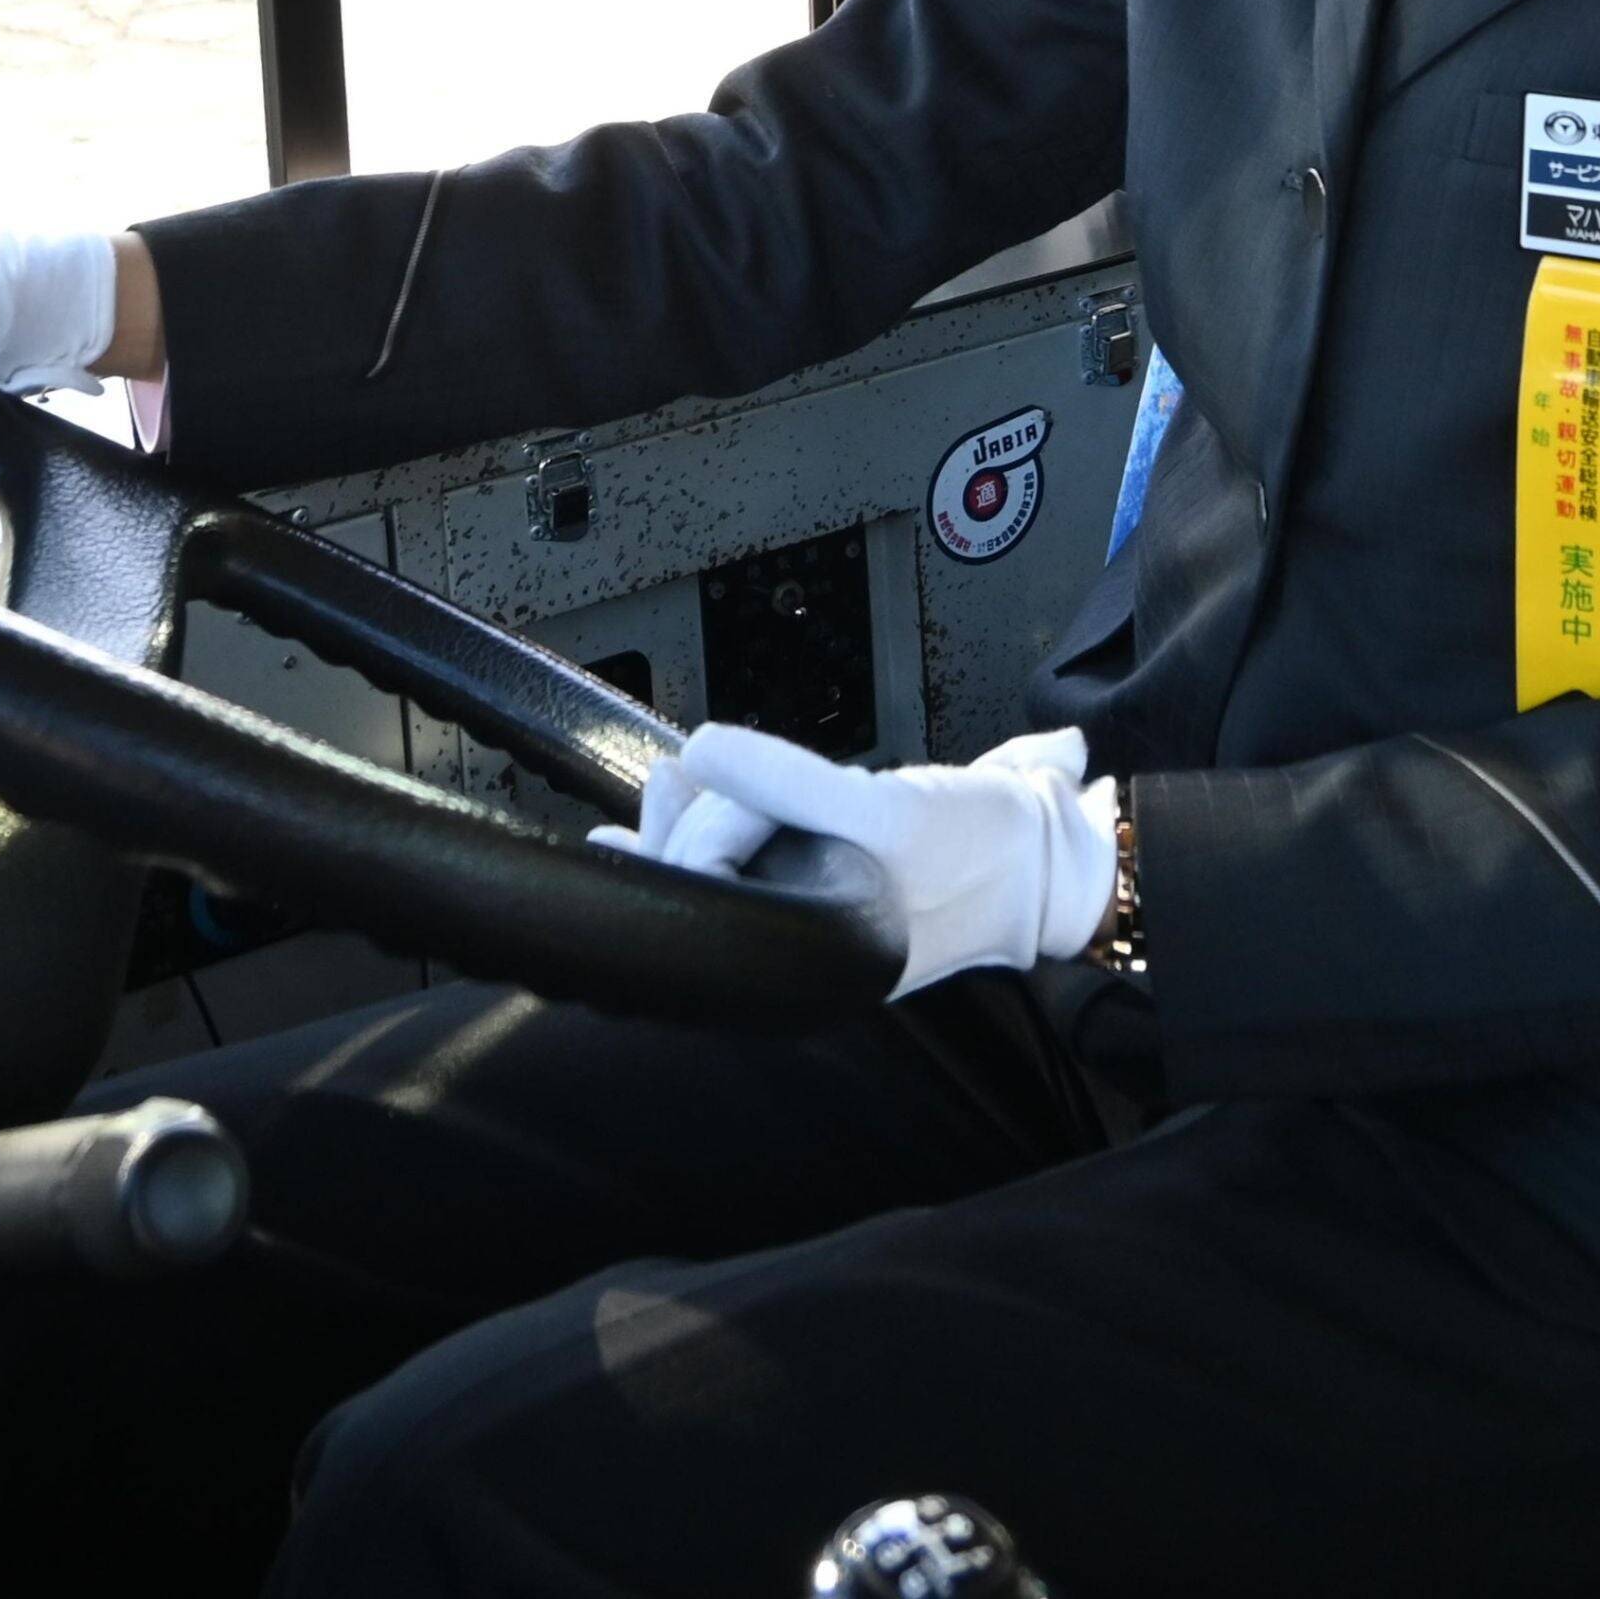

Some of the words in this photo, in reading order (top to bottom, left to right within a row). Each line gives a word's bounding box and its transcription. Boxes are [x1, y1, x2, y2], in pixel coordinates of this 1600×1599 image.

[973, 424, 1038, 465] JABIA
[1531, 390, 1551, 448] 年始
[1559, 544, 1595, 646] 実施中
